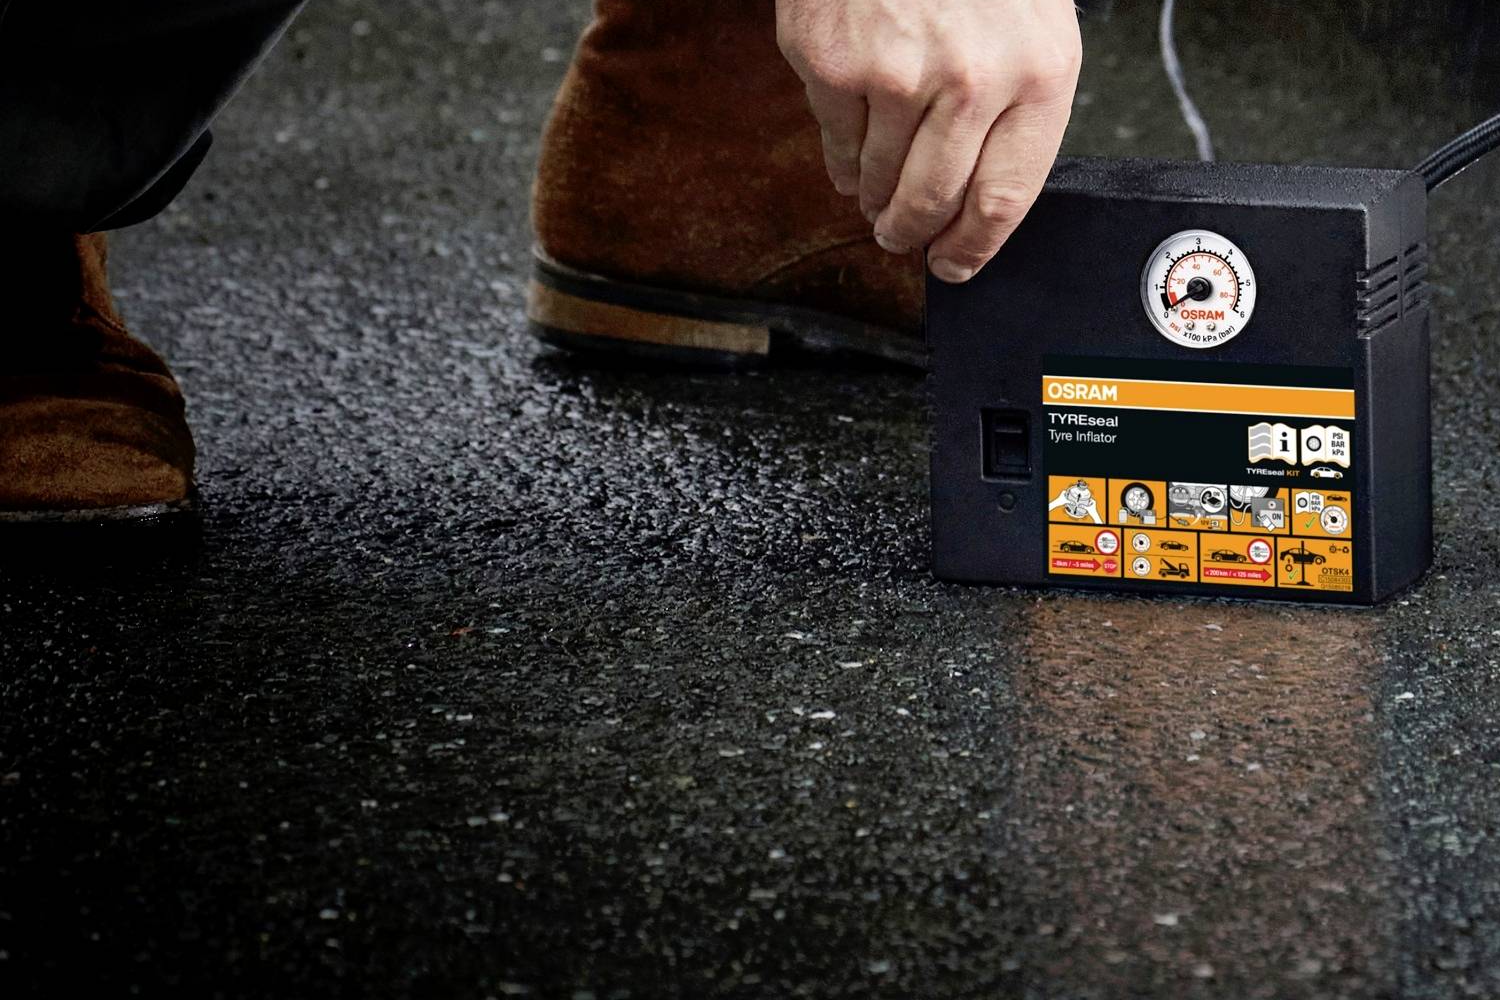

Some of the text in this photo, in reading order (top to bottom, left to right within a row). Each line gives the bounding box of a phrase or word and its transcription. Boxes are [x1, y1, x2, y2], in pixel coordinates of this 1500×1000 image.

[1195, 237, 1201, 245] 3
[1165, 251, 1172, 259] 2
[1228, 248, 1233, 256] 4
[1154, 283, 1159, 291] 1
[1163, 311, 1169, 319] 0
[1181, 309, 1225, 321] OSRAM
[1239, 311, 1245, 319] 6
[1169, 321, 1181, 333] psi
[1182, 325, 1236, 343] x100 kPa (bar)
[1047, 382, 1118, 402] OSRAM
[1047, 412, 1119, 428] TYREseal
[1047, 428, 1117, 443] Tyre Inflator
[1332, 432, 1344, 440] PSI
[1331, 440, 1345, 449] BAR
[1332, 448, 1345, 457] kPa
[1246, 467, 1301, 478] TYREseal KIT
[1272, 512, 1282, 520] ON
[1103, 562, 1117, 570] STOP
[1321, 566, 1350, 576] OTSK4
